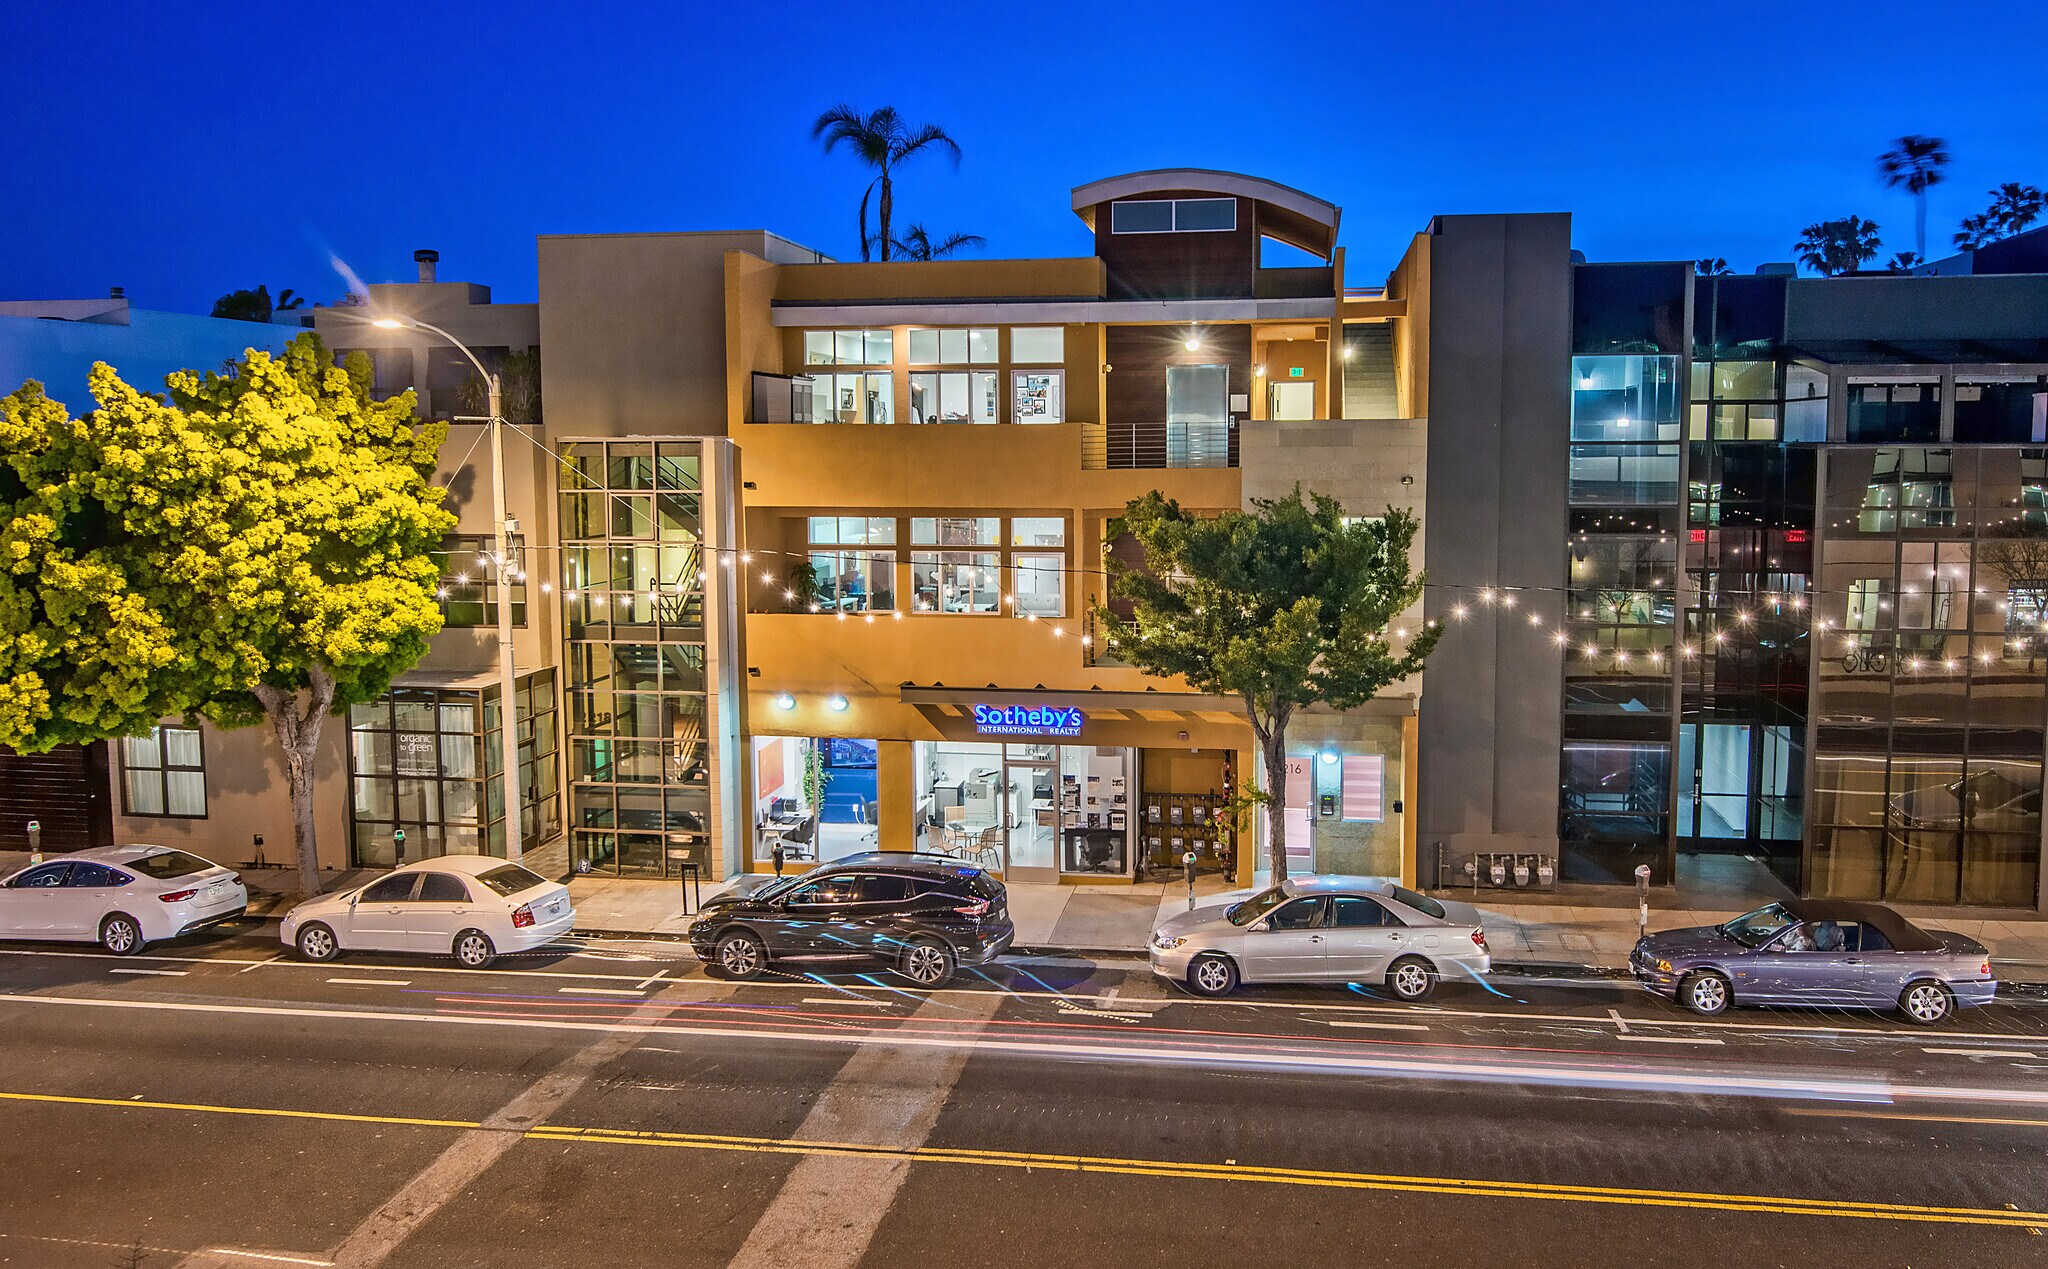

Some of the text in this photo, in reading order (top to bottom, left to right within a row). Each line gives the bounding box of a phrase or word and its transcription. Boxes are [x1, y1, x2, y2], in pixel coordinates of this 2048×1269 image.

[975, 704, 1082, 727] Sotheby's
[978, 725, 1080, 736] INTERNATIONAL REALTY
[399, 734, 433, 744] organic
[407, 742, 434, 756] green
